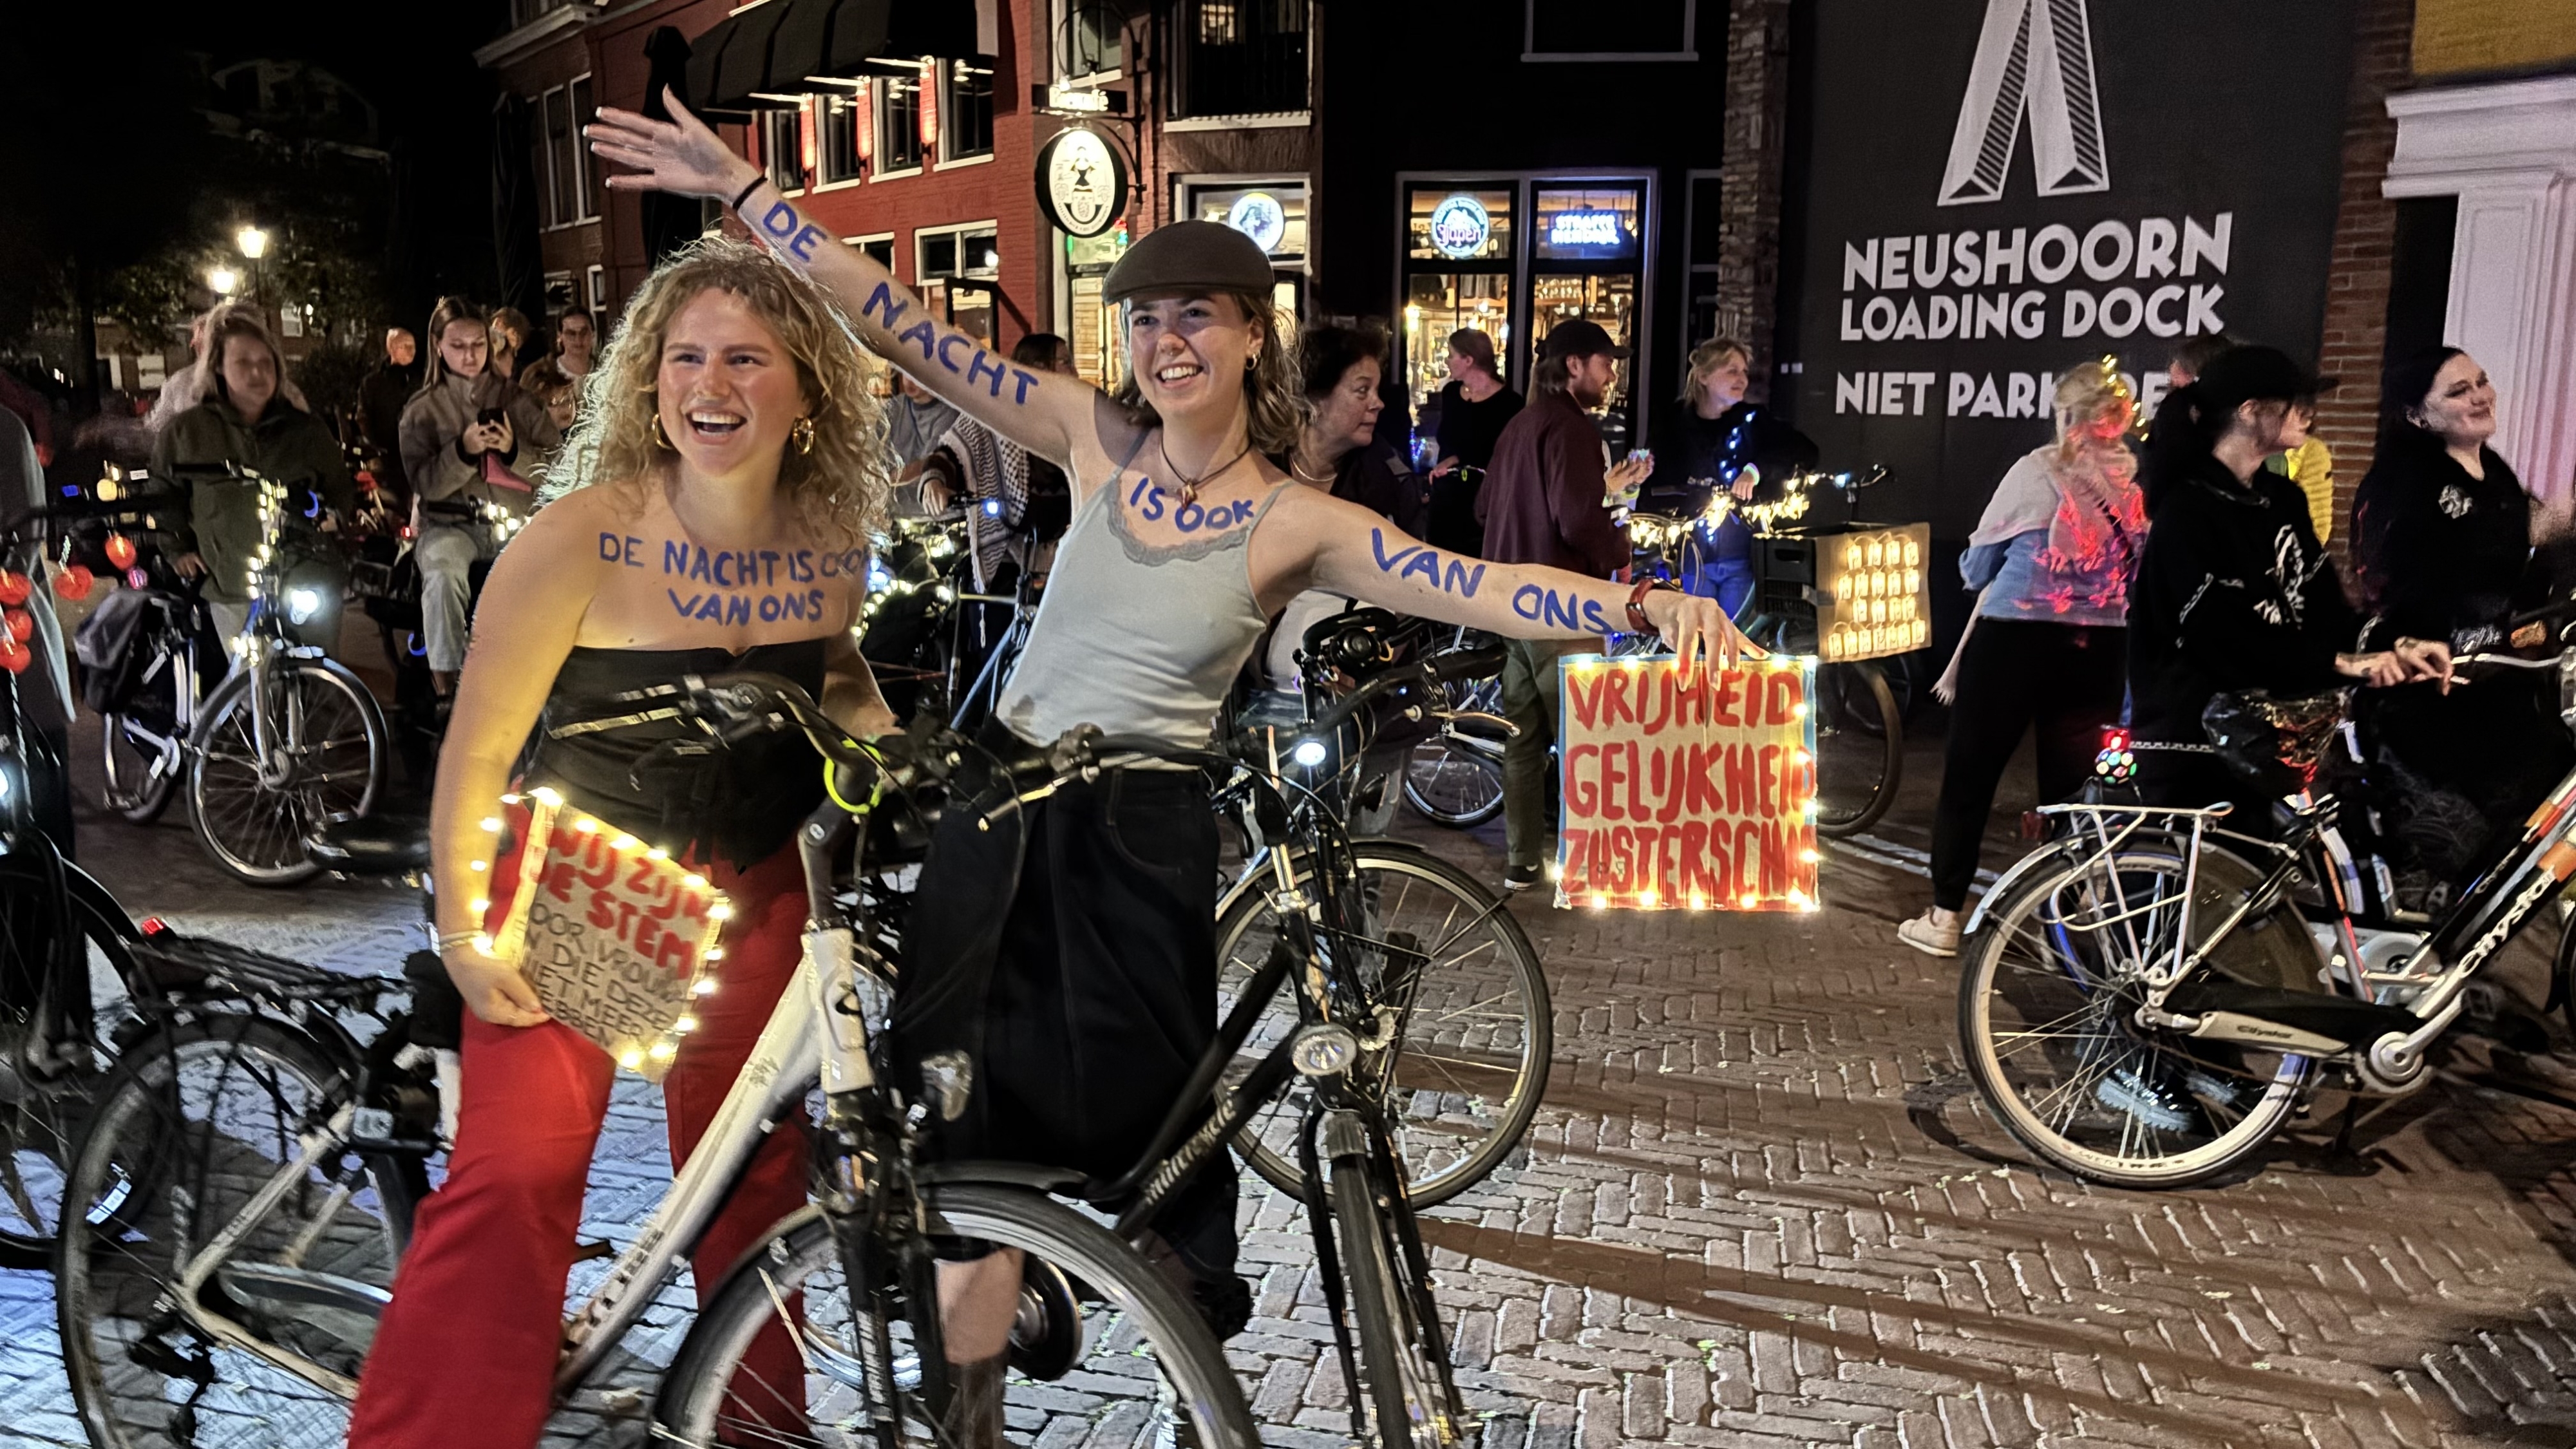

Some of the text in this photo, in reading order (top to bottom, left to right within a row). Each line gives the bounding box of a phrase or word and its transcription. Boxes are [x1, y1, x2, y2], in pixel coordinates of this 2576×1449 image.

[1843, 211, 2233, 291] NEUSHOORN
[762, 202, 1039, 404] DE NACHT
[1841, 284, 2225, 341] LOADING DOCK
[1835, 372, 2170, 421] NIET PARKE
[1130, 477, 1255, 533] IS OOK
[600, 532, 644, 567] DE
[664, 540, 781, 587] NACHT
[788, 549, 815, 583] IS
[1372, 527, 1613, 635] VAN ONS
[667, 588, 825, 627] VAN ONS
[1567, 668, 1804, 735] VRIJHEID
[1564, 740, 1817, 823] GELIJKHEID
[529, 902, 588, 954] OOR
[586, 889, 696, 980] STEM
[551, 942, 605, 989] DIE
[540, 989, 611, 1047] EBBEN
[581, 989, 644, 1041] MEER
